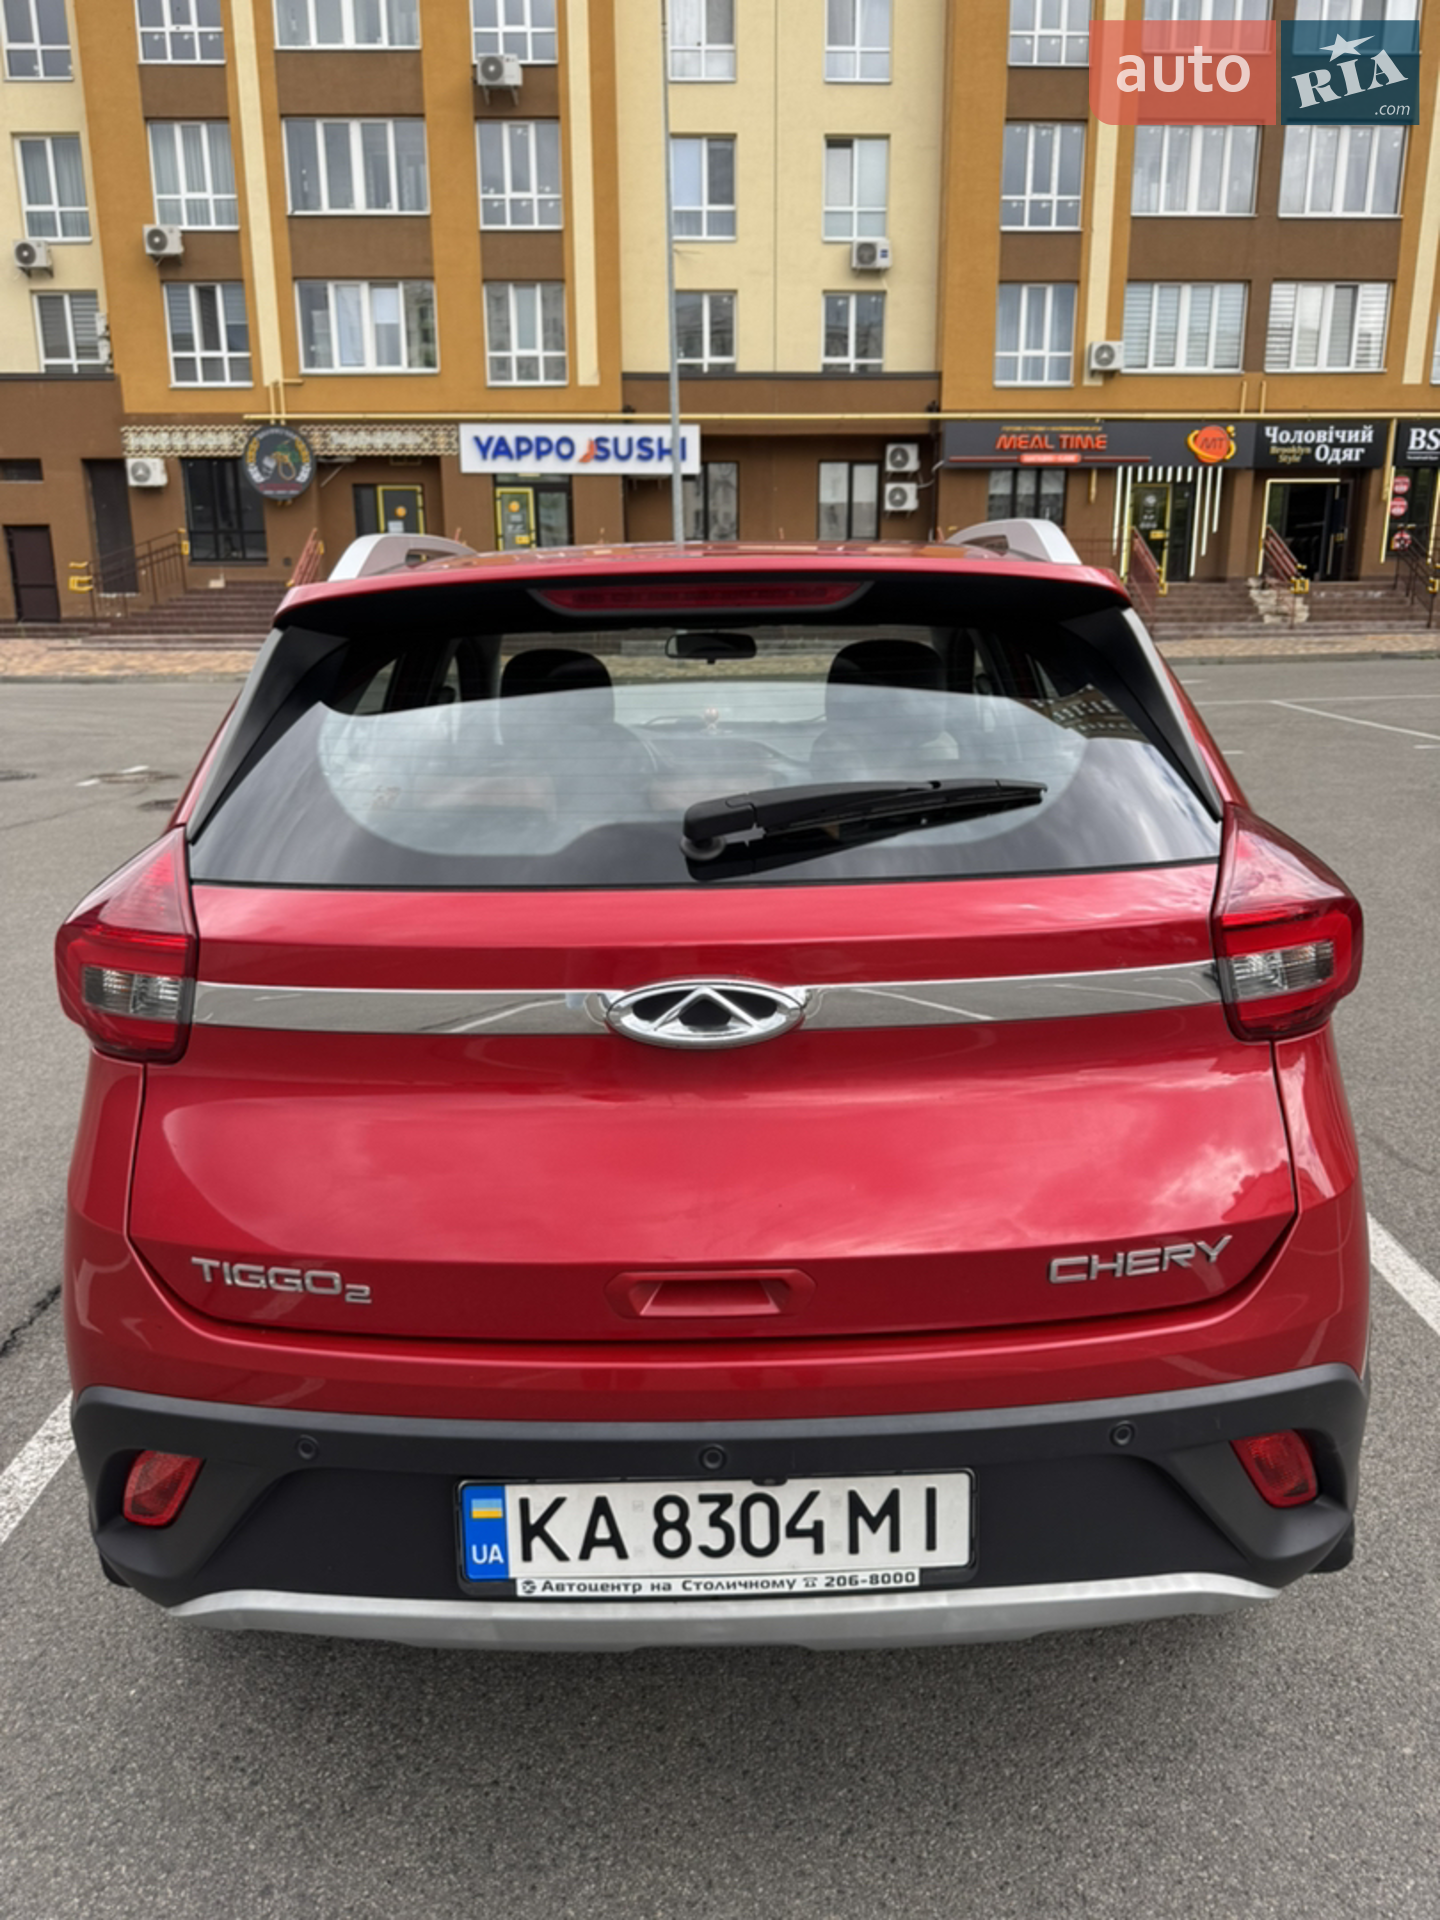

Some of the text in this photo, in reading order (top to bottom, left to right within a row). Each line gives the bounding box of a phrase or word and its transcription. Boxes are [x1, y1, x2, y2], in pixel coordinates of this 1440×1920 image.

[995, 434, 1107, 449] MEAL TIME
[1200, 437, 1224, 449] MT
[1264, 425, 1374, 444] Чоловічий
[473, 436, 687, 462] YAPPO SUSHI
[1315, 444, 1366, 465] Одяг
[1049, 1235, 1233, 1284] CHERY
[518, 1486, 938, 1563] KA 8304 MI
[472, 1543, 505, 1566] UA
[541, 1571, 917, 1595] Автоцентр на Столичному 206-8000
